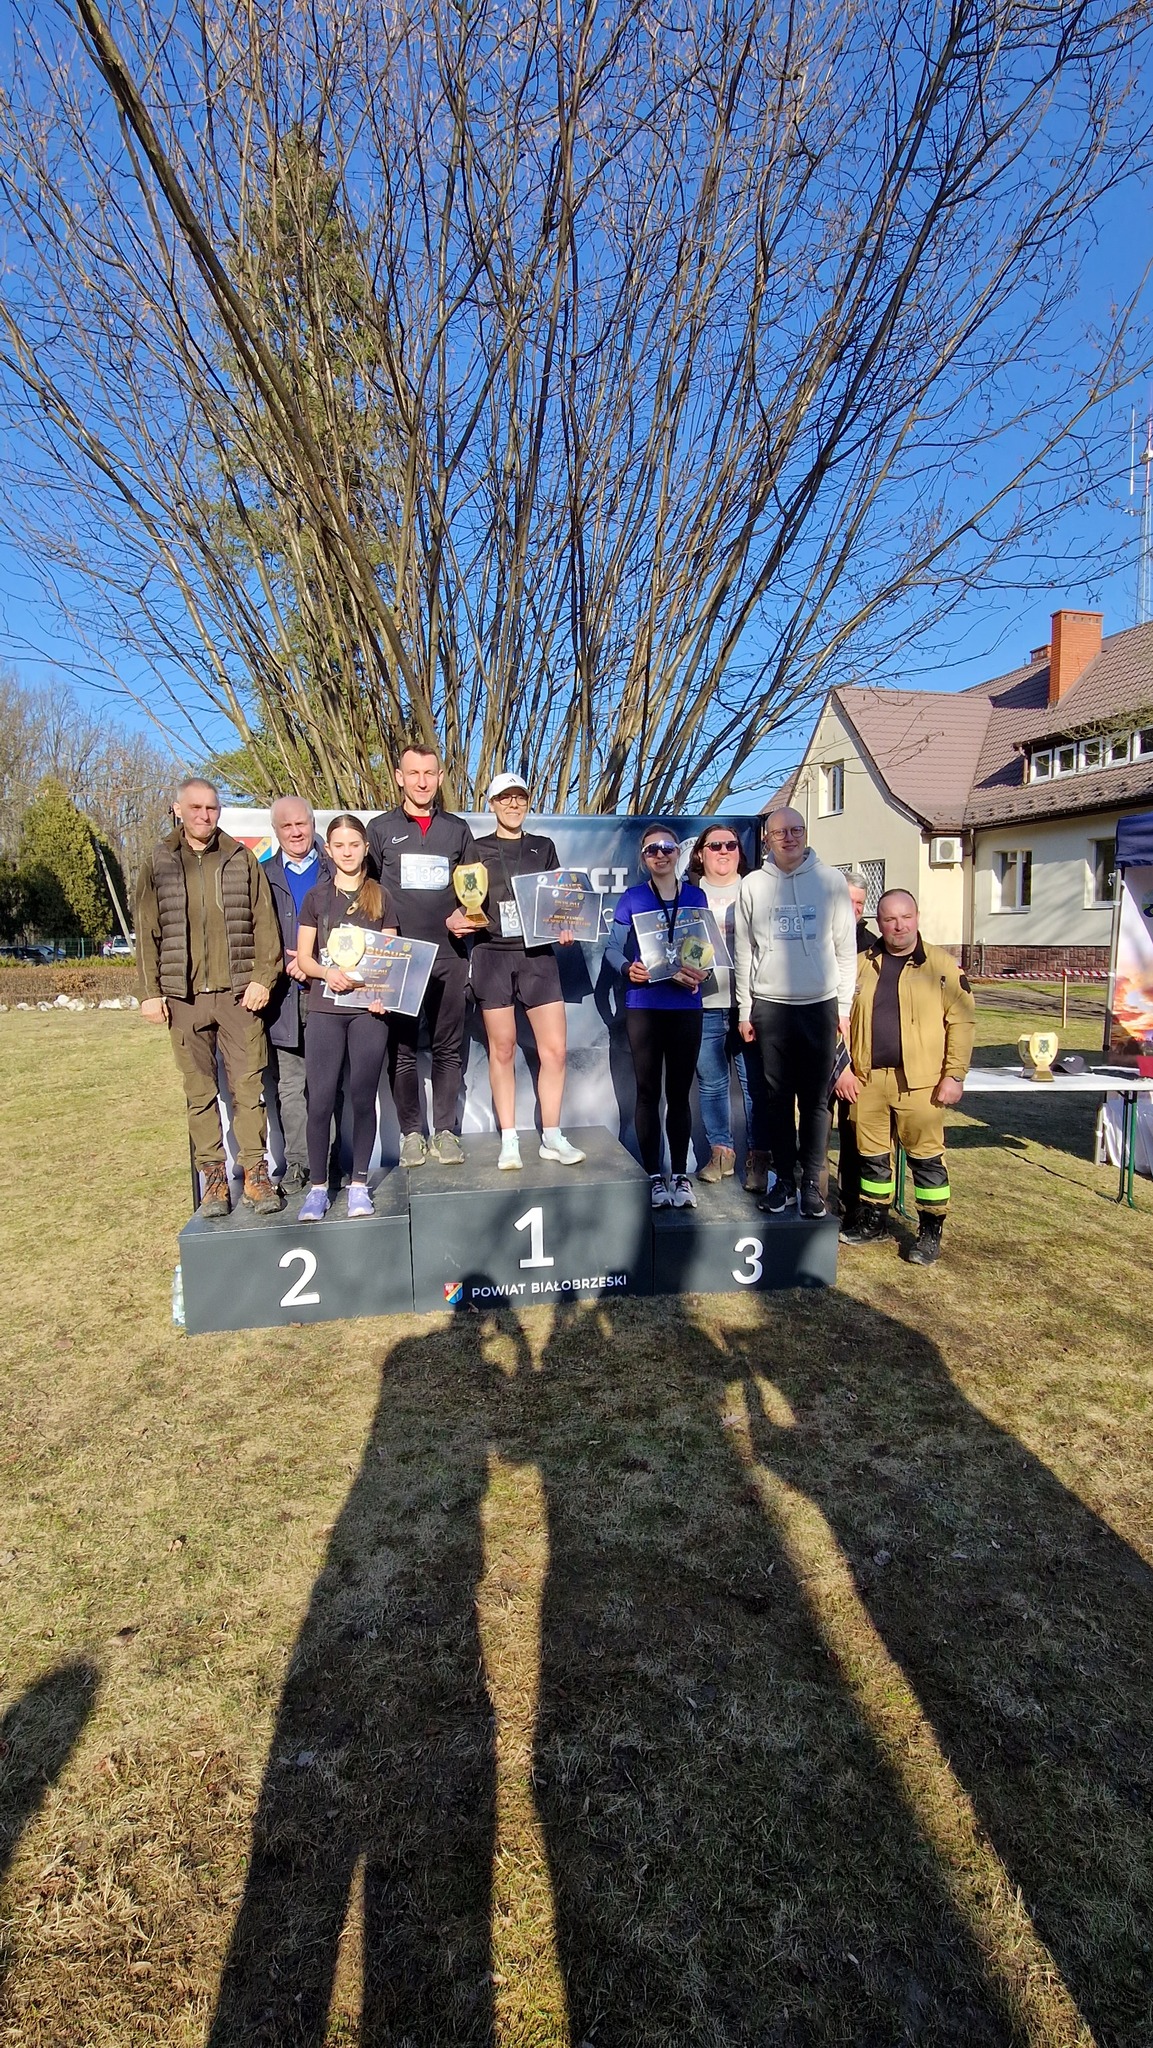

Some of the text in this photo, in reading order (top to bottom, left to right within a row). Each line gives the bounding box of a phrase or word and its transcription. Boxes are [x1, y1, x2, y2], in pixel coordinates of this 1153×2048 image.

[405, 865, 445, 883] 532
[778, 916, 806, 933] 38
[513, 1206, 555, 1269] 1
[278, 1248, 321, 1308] 2
[731, 1236, 764, 1285] 3
[471, 1275, 627, 1298] POWIAT BIAŁOBRZESKI
